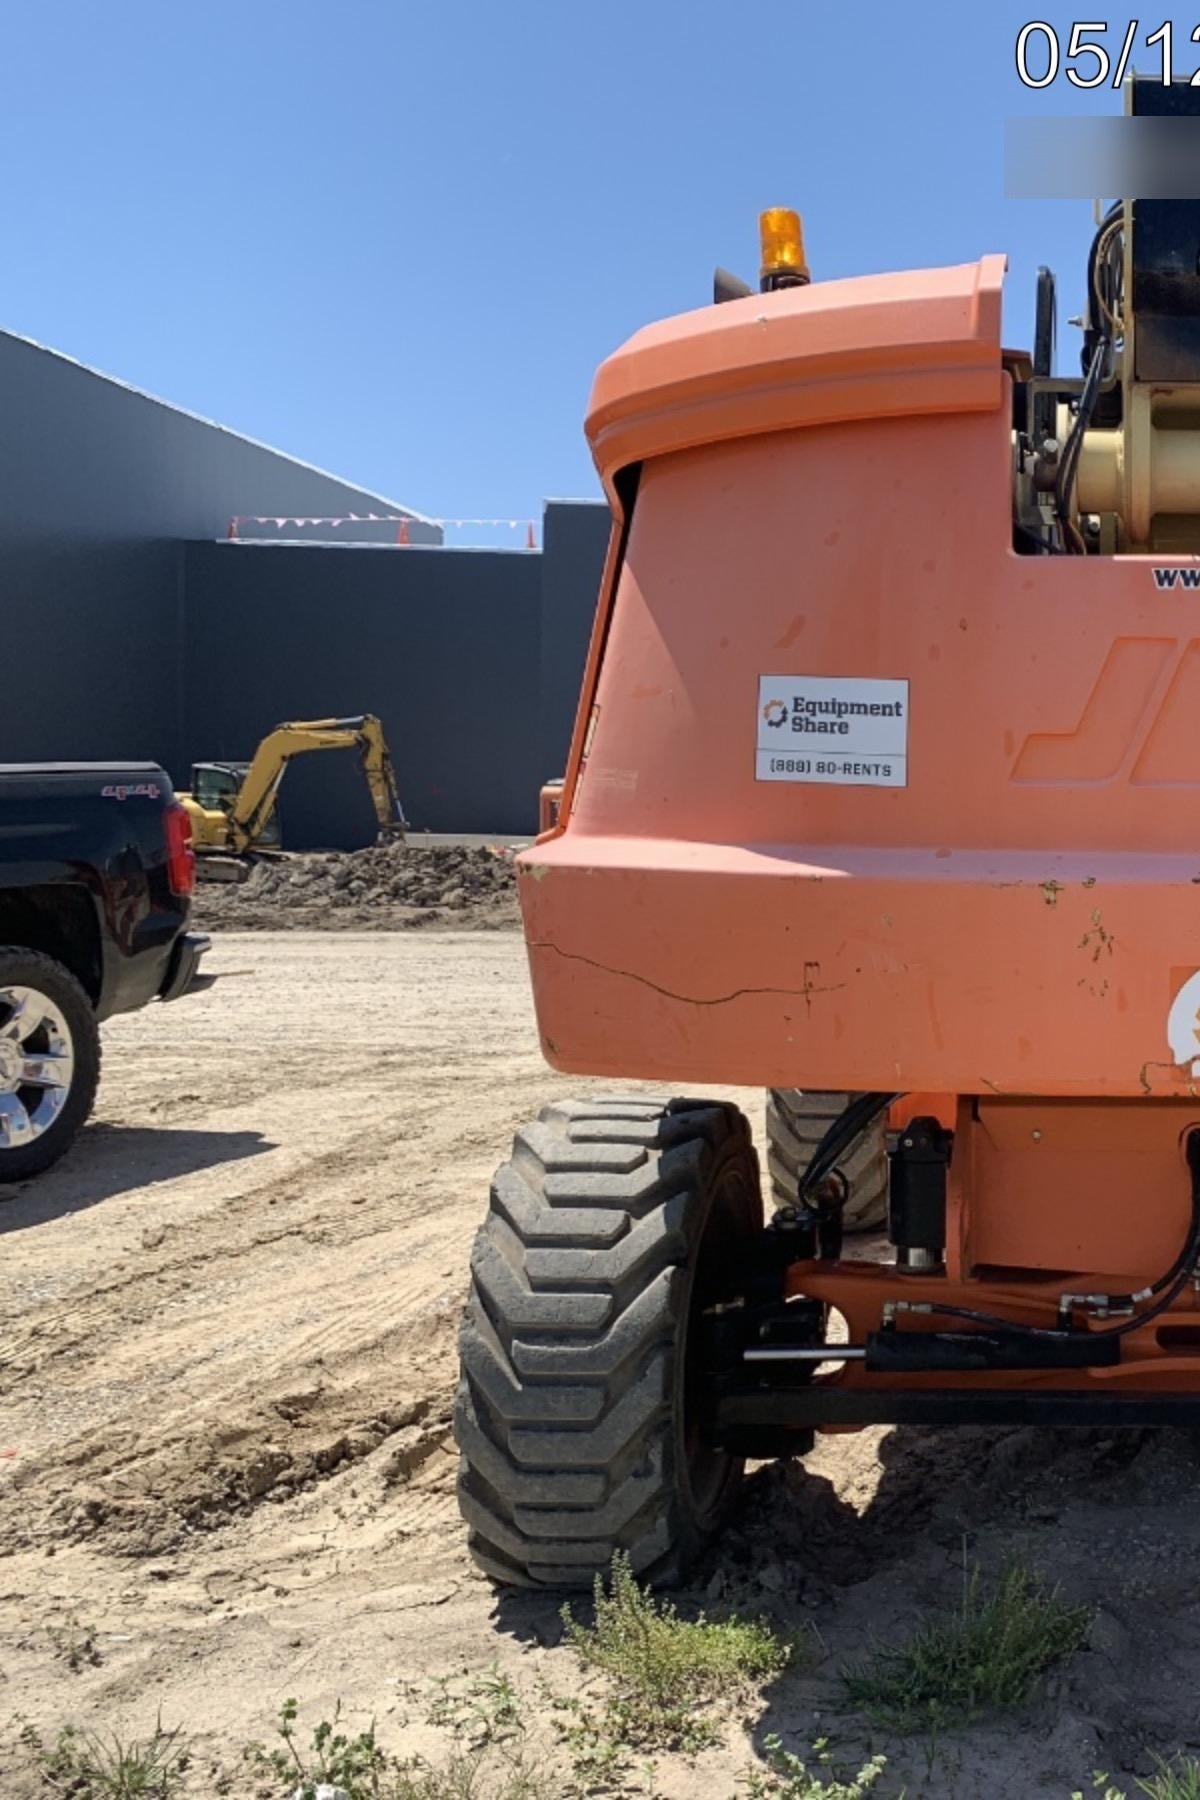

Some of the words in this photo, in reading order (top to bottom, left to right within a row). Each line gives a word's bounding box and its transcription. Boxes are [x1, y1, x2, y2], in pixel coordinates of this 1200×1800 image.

[792, 697, 903, 718] Equipment
[791, 716, 849, 735] Share
[770, 758, 811, 774] (888)
[815, 760, 892, 777] 80-RENTS
